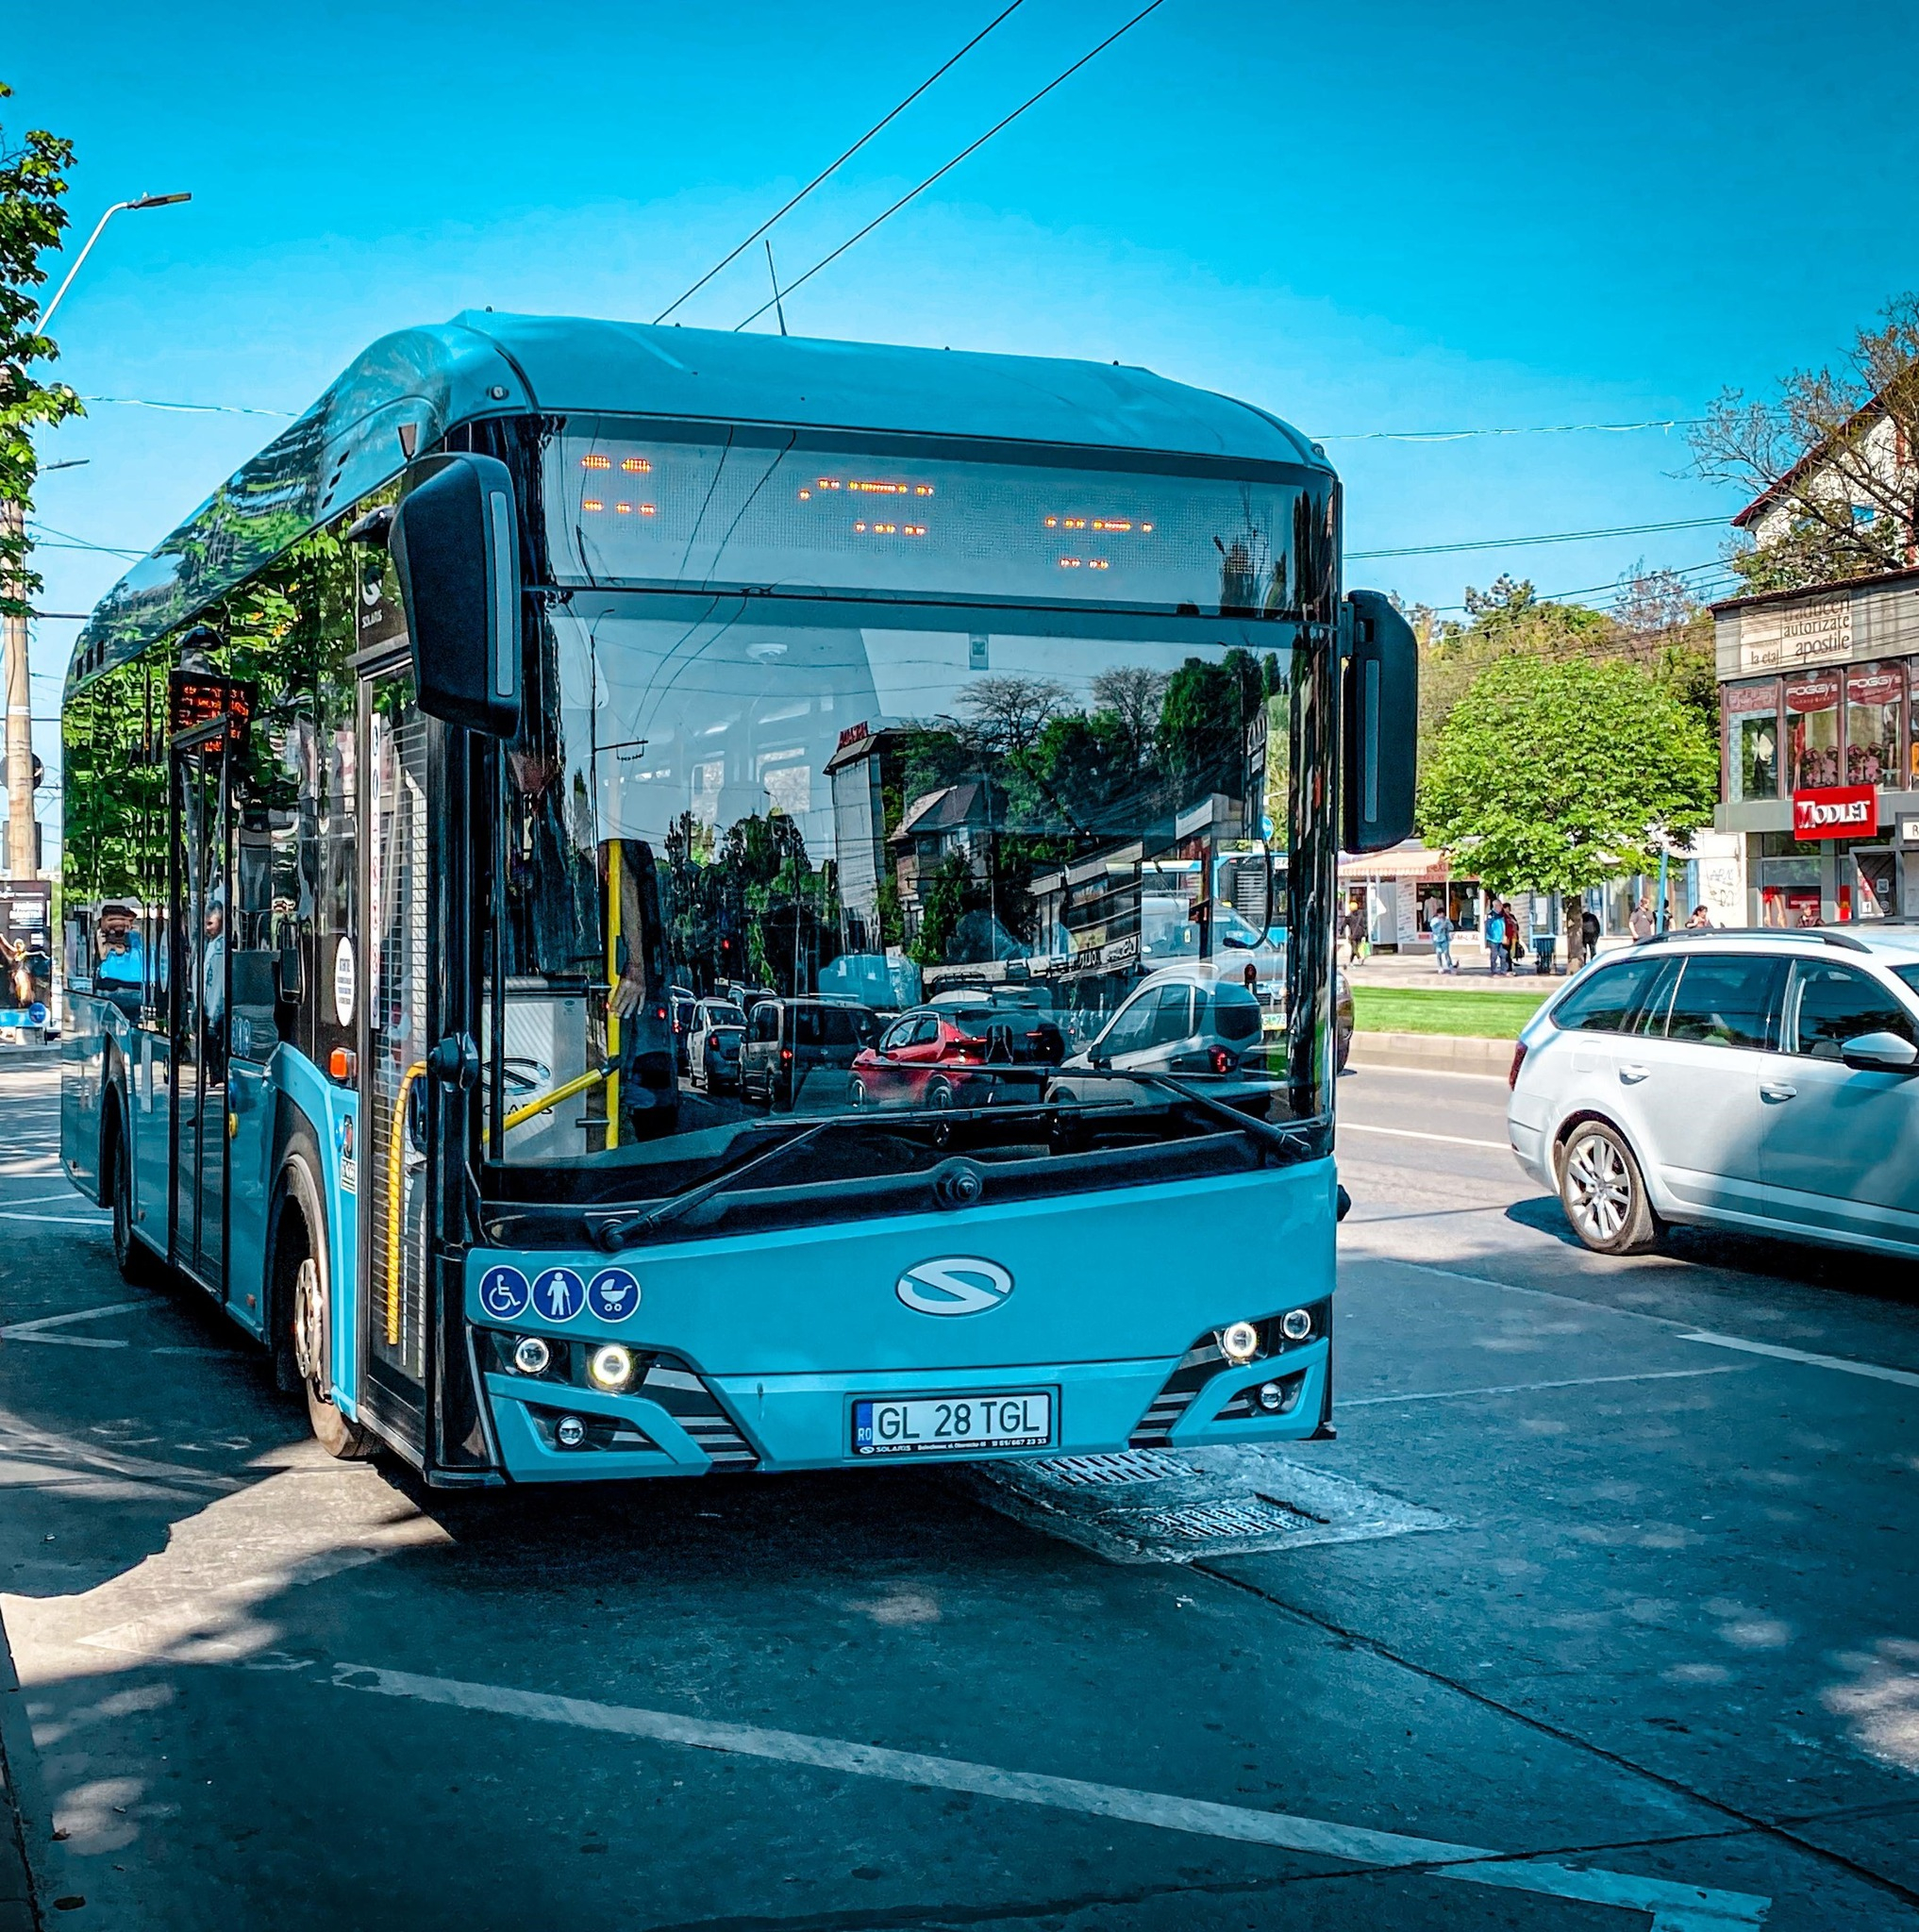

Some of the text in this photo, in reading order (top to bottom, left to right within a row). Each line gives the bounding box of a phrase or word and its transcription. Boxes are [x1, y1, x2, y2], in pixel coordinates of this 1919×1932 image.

[1784, 615, 1850, 638] autorizate
[1751, 651, 1760, 664] la
[1795, 630, 1850, 664] apostile
[877, 1400, 1040, 1440] GL 28 TGL
[858, 1427, 872, 1441] RO
